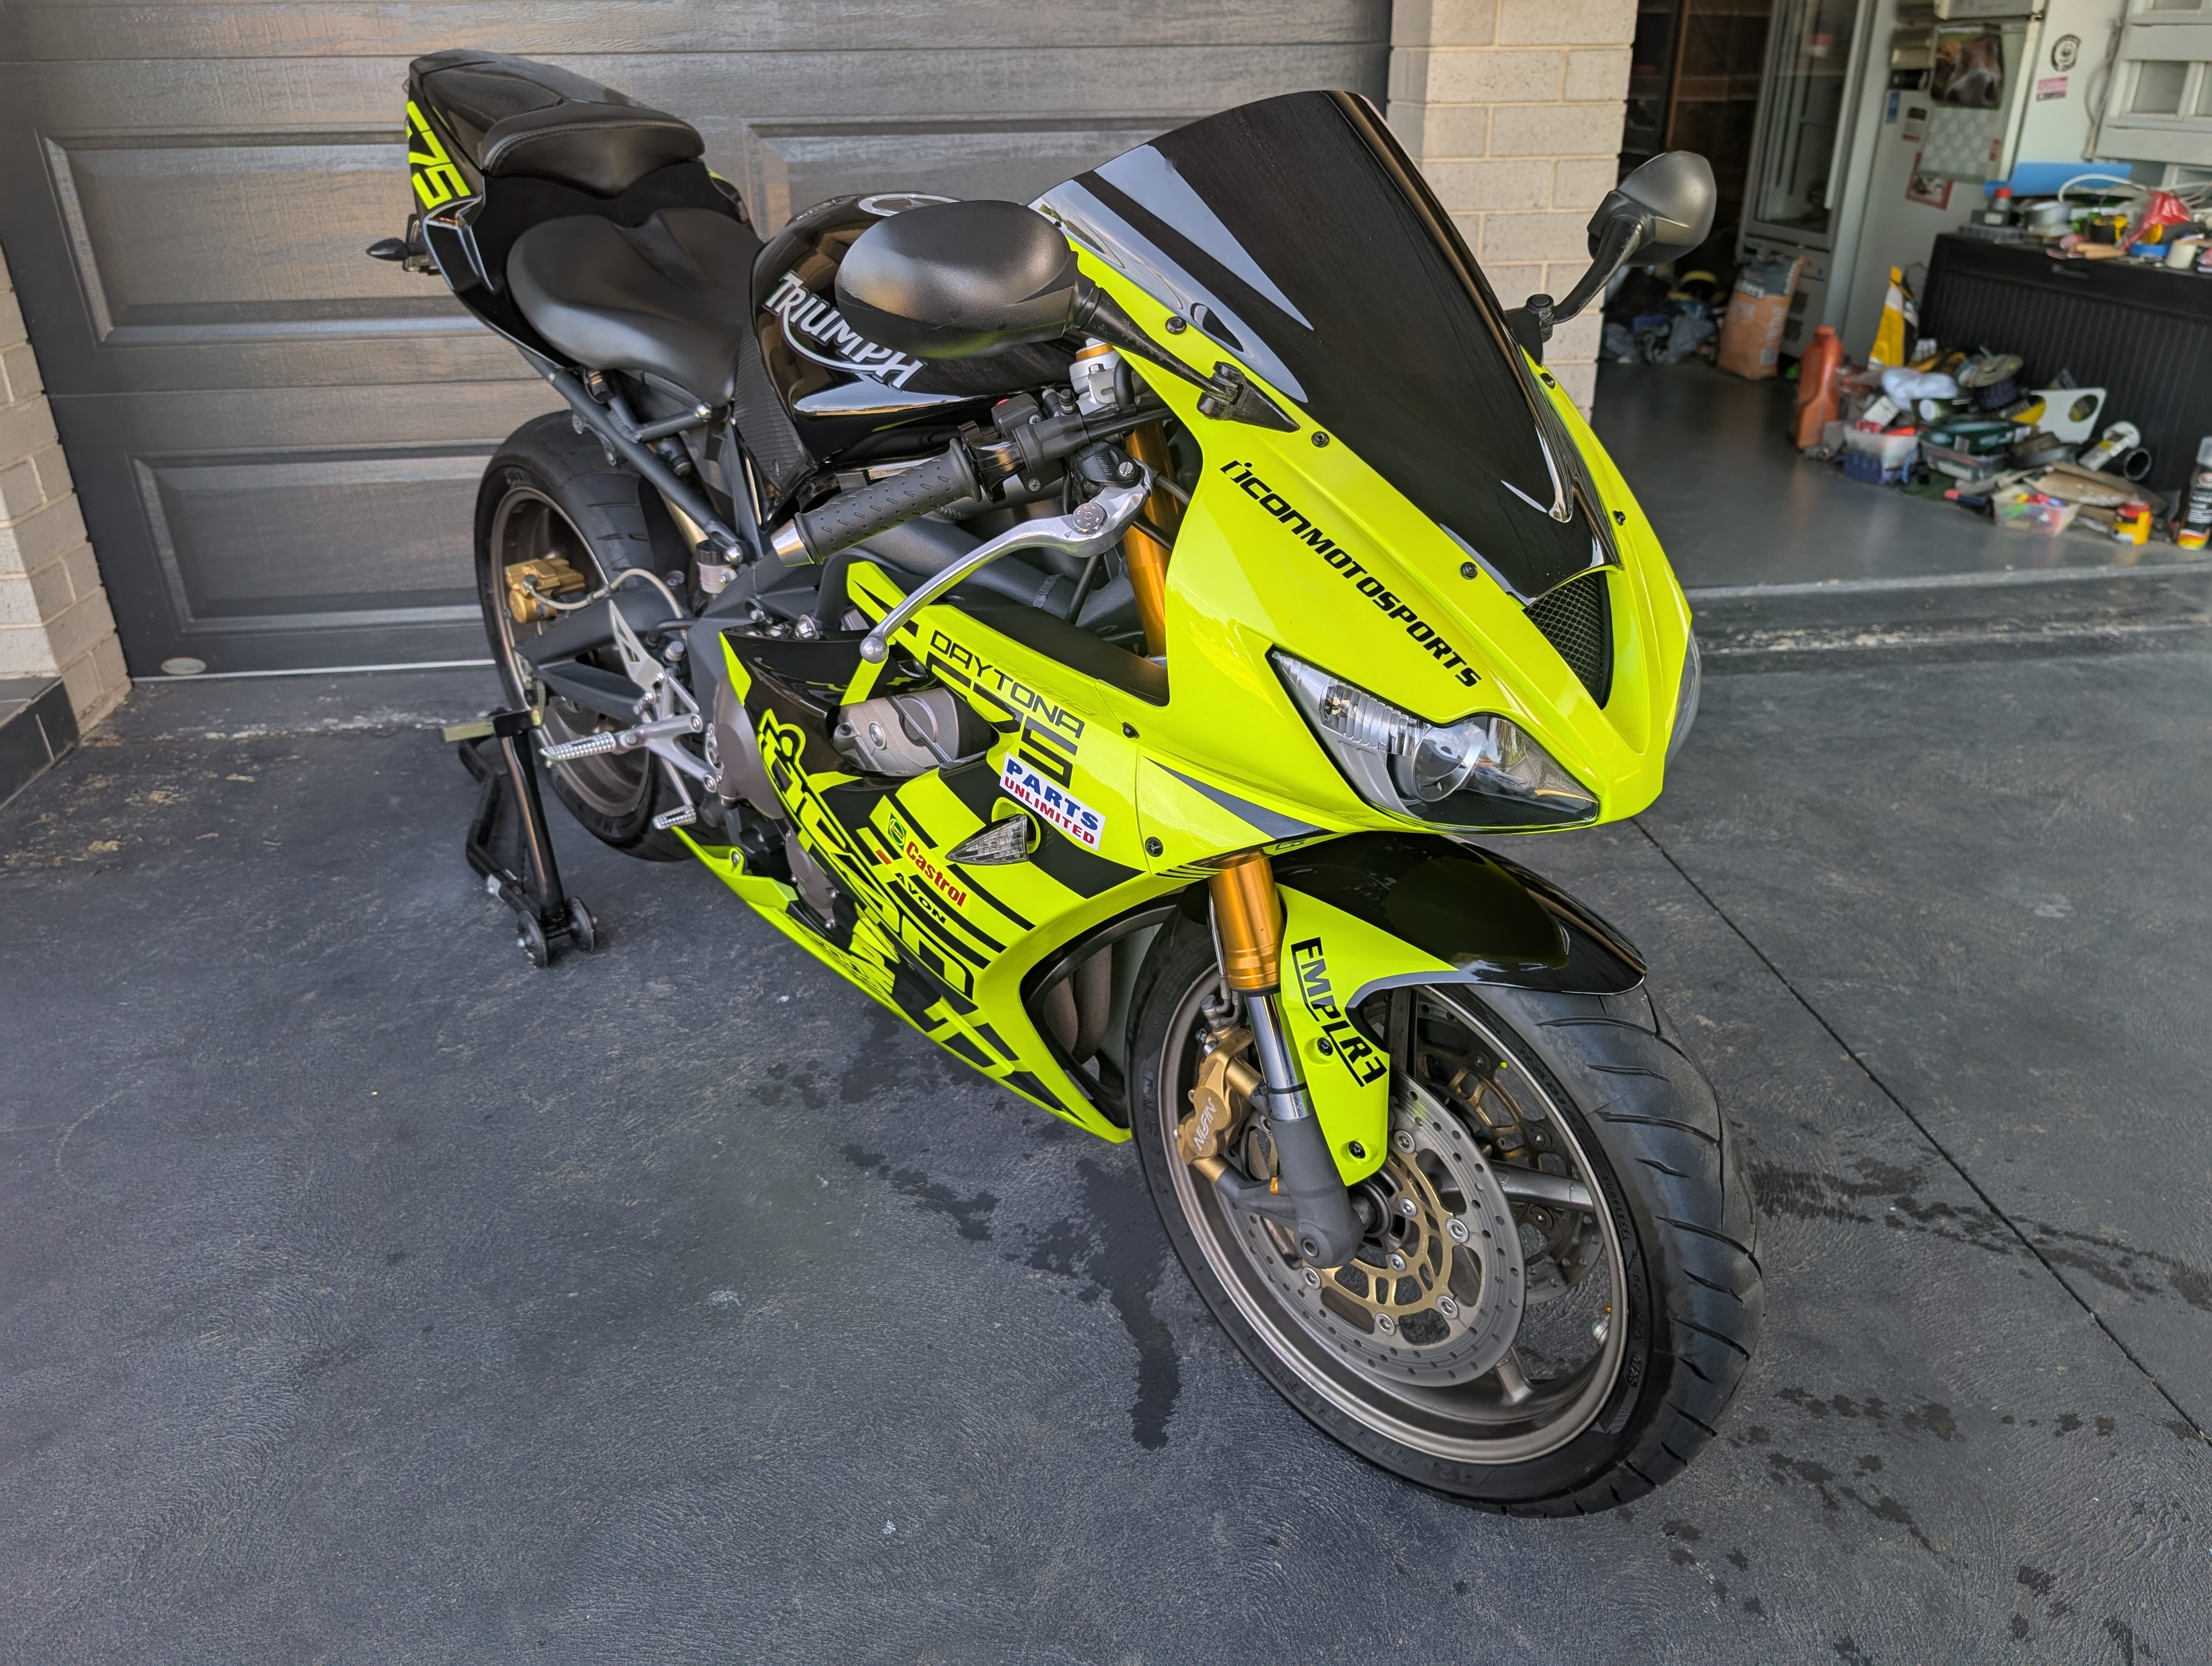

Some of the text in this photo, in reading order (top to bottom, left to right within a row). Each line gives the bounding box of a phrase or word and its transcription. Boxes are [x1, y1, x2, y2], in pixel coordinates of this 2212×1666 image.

[762, 270, 928, 393] TRIUMPH
[930, 630, 1085, 739] DAYTONA
[1005, 776, 1095, 844] UNLIMITED
[1006, 758, 1098, 830] PARTS
[895, 873, 947, 924] AVON
[906, 841, 967, 907] Castrol
